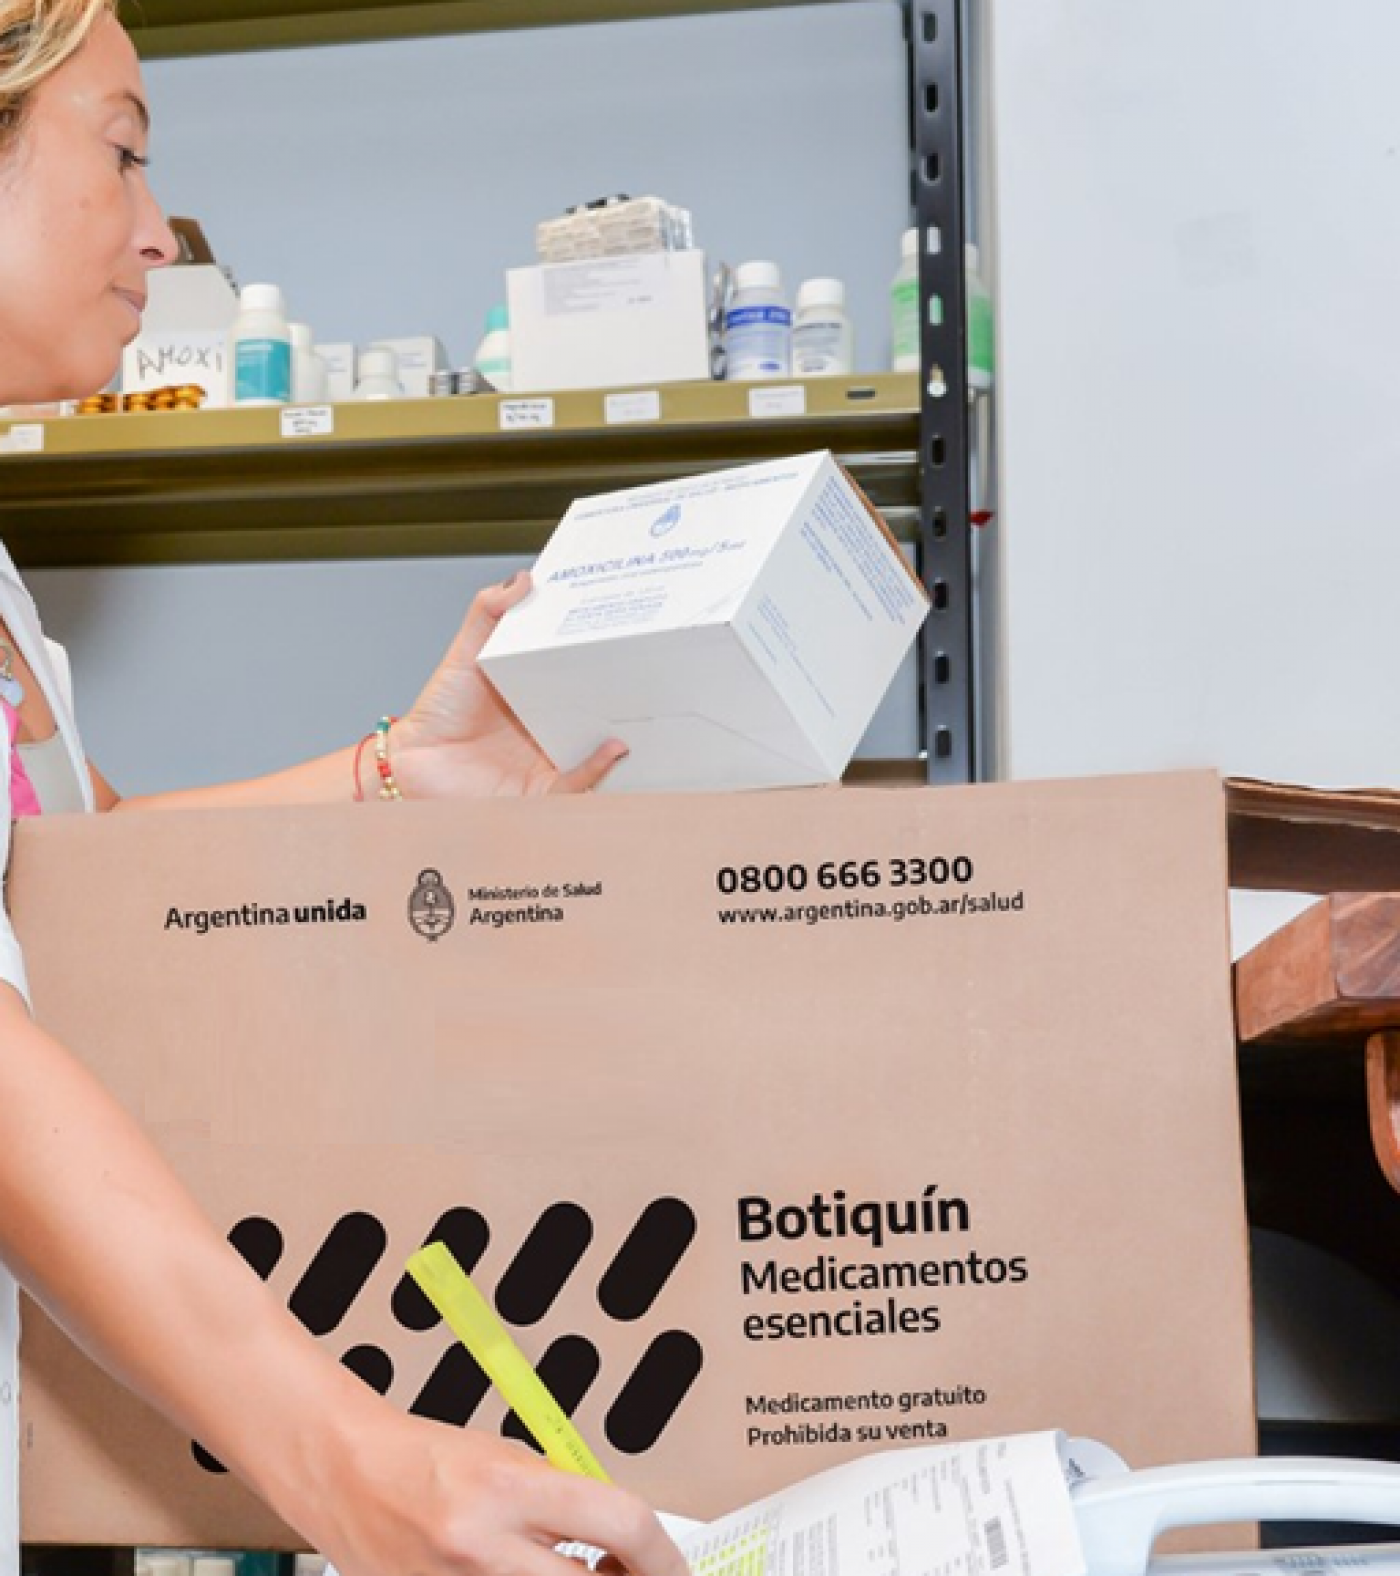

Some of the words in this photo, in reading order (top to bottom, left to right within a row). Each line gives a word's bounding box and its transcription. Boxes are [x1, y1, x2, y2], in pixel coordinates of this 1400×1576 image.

[467, 886, 540, 901] Ministerio
[541, 883, 560, 898] de
[562, 880, 602, 898] Salud
[716, 863, 809, 895] 0800
[816, 859, 882, 890] 666
[888, 855, 975, 886] 3300
[163, 902, 291, 936] Argentina
[293, 897, 367, 924] unida
[469, 902, 564, 928] Argentina
[717, 890, 1024, 925] www.argentina.gob.ar/salud
[736, 1184, 971, 1248] Botiquín
[740, 1250, 1029, 1295] Medicamentos
[743, 1296, 941, 1341] esenciales
[745, 1390, 895, 1415] Medicamento
[898, 1384, 987, 1413] gratuito
[746, 1421, 852, 1447] Prohibida
[855, 1425, 883, 1442] su
[884, 1419, 949, 1441] venta
